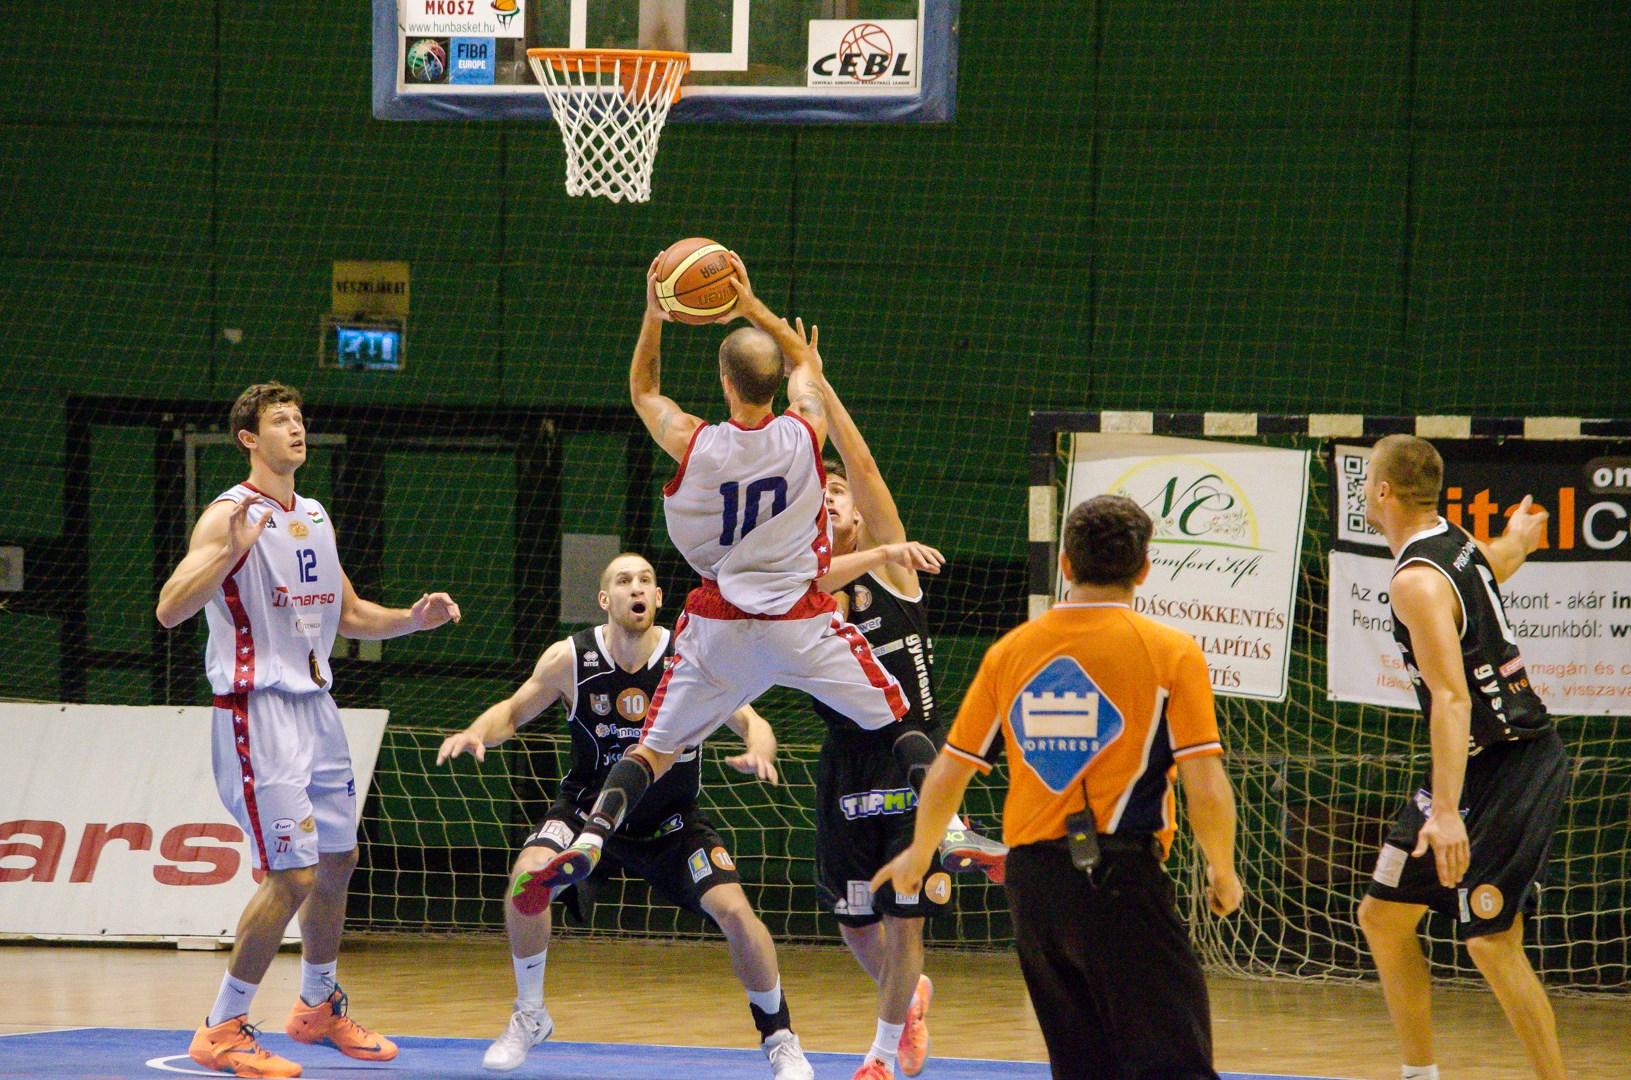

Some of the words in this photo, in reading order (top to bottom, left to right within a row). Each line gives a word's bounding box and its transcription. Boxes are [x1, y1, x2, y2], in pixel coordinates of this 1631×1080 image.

[425, 0, 475, 15] MKOSZ
[408, 20, 495, 33] www.hunbasket.hu
[457, 43, 488, 59] FIBA
[458, 60, 486, 70] EUROPE
[812, 53, 911, 76] CEBL
[719, 476, 788, 546] 10
[296, 549, 318, 583] 12
[1567, 591, 1606, 609] akár
[622, 694, 645, 714] 10
[0, 819, 267, 886] ars
[936, 880, 946, 898] 4
[1479, 892, 1494, 912] 6
